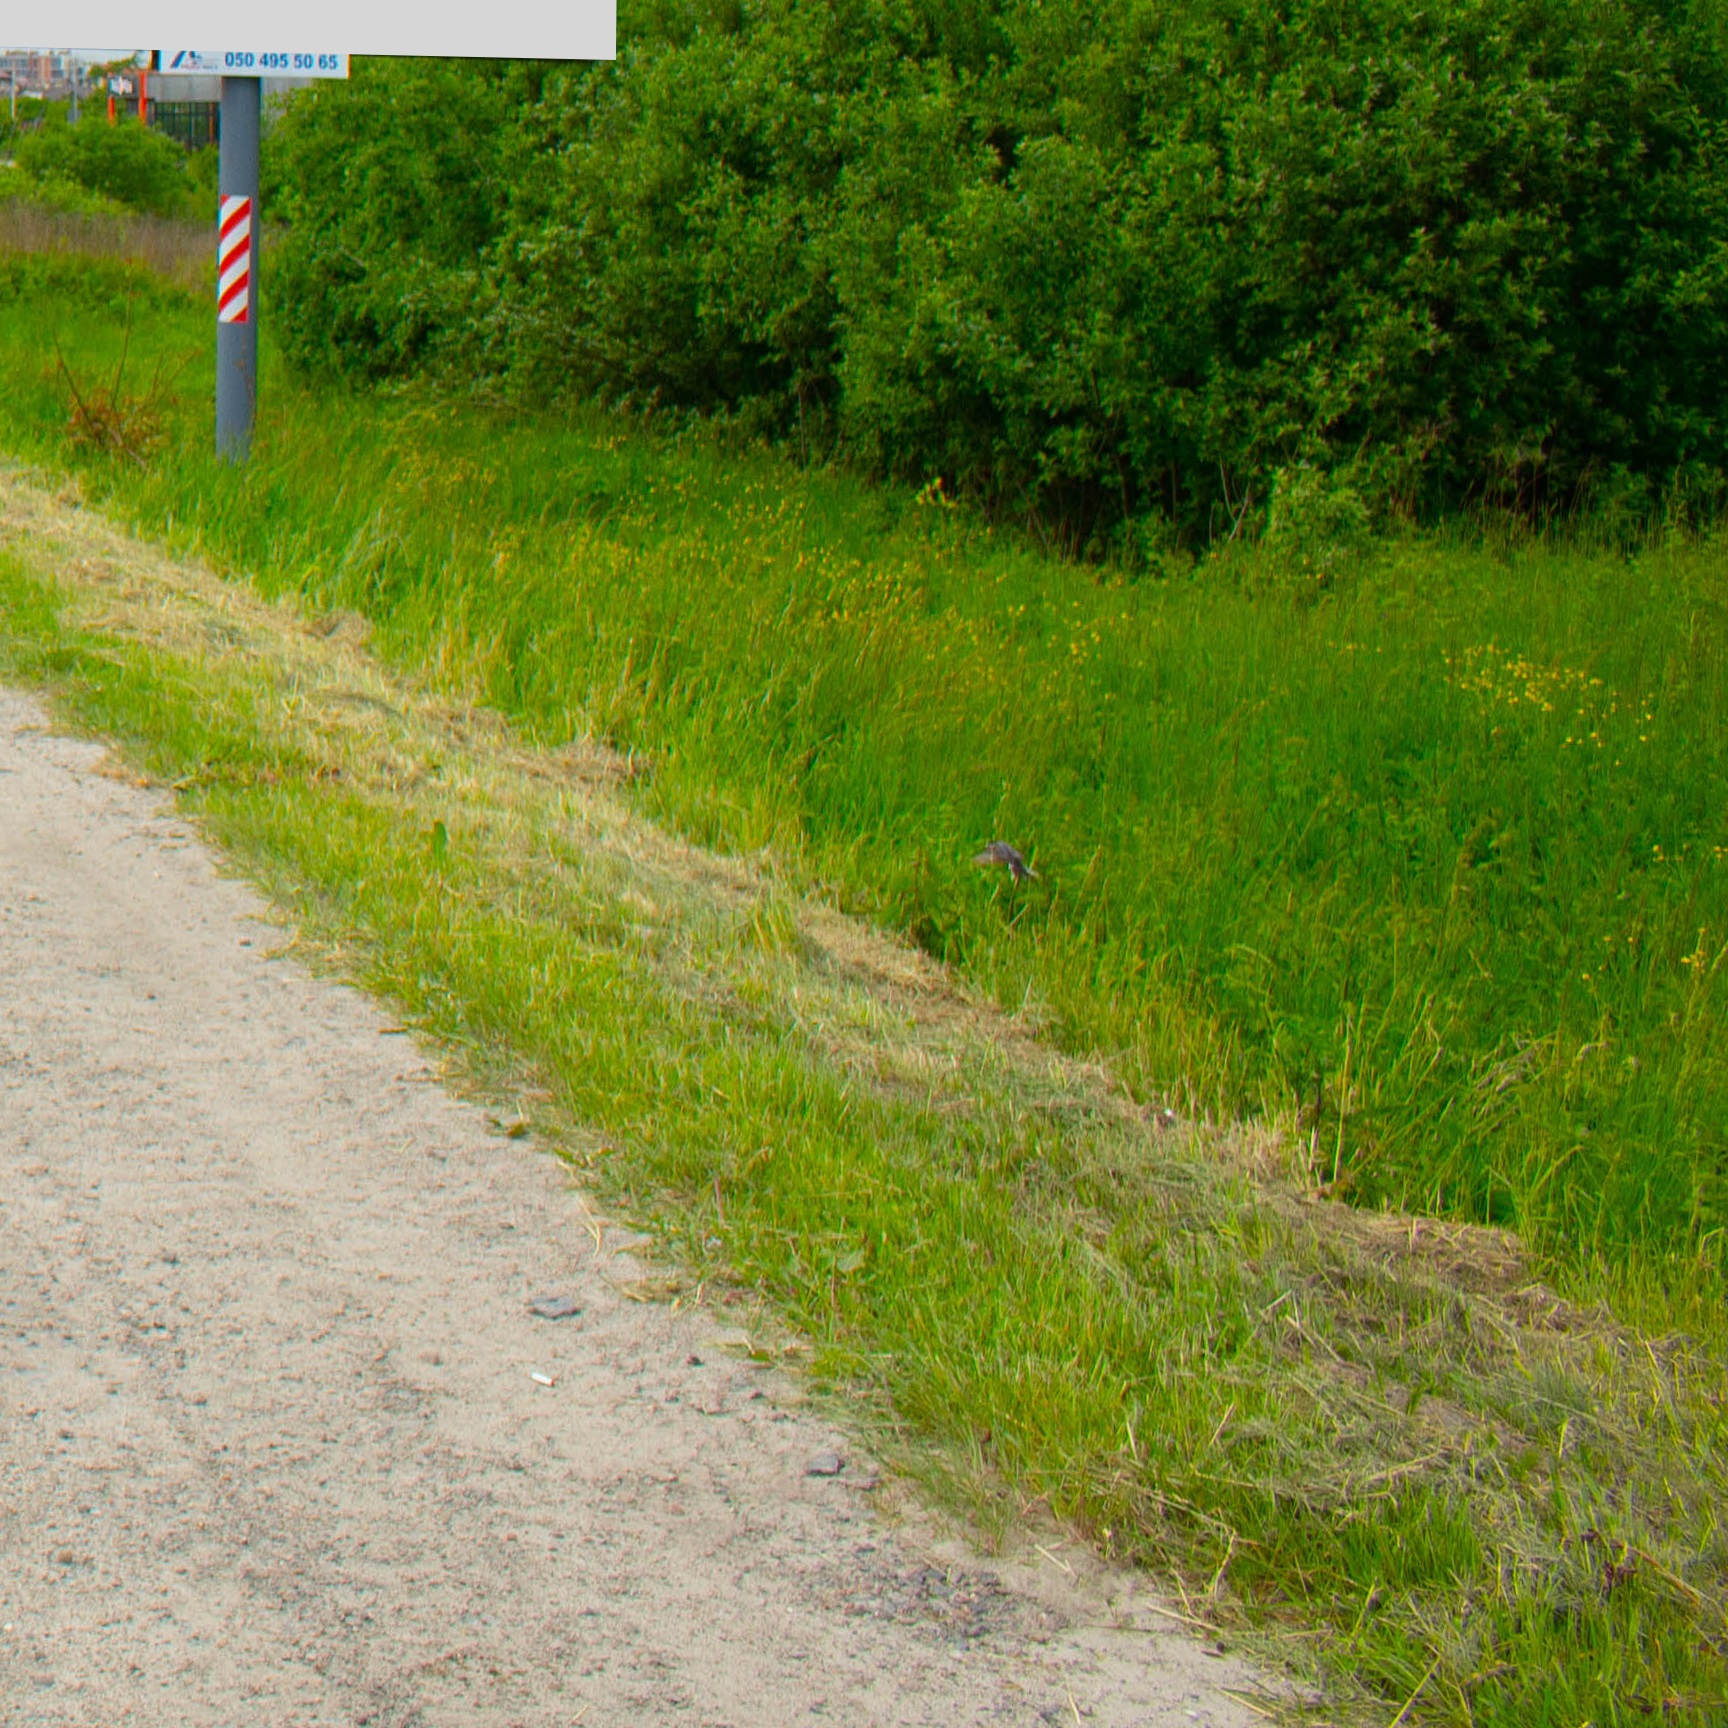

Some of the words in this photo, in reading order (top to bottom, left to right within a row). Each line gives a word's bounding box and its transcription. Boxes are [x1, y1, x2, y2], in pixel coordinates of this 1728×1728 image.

[225, 51, 255, 68] 050
[259, 52, 289, 69] 495
[294, 53, 315, 69] 50
[318, 54, 339, 70] 65
